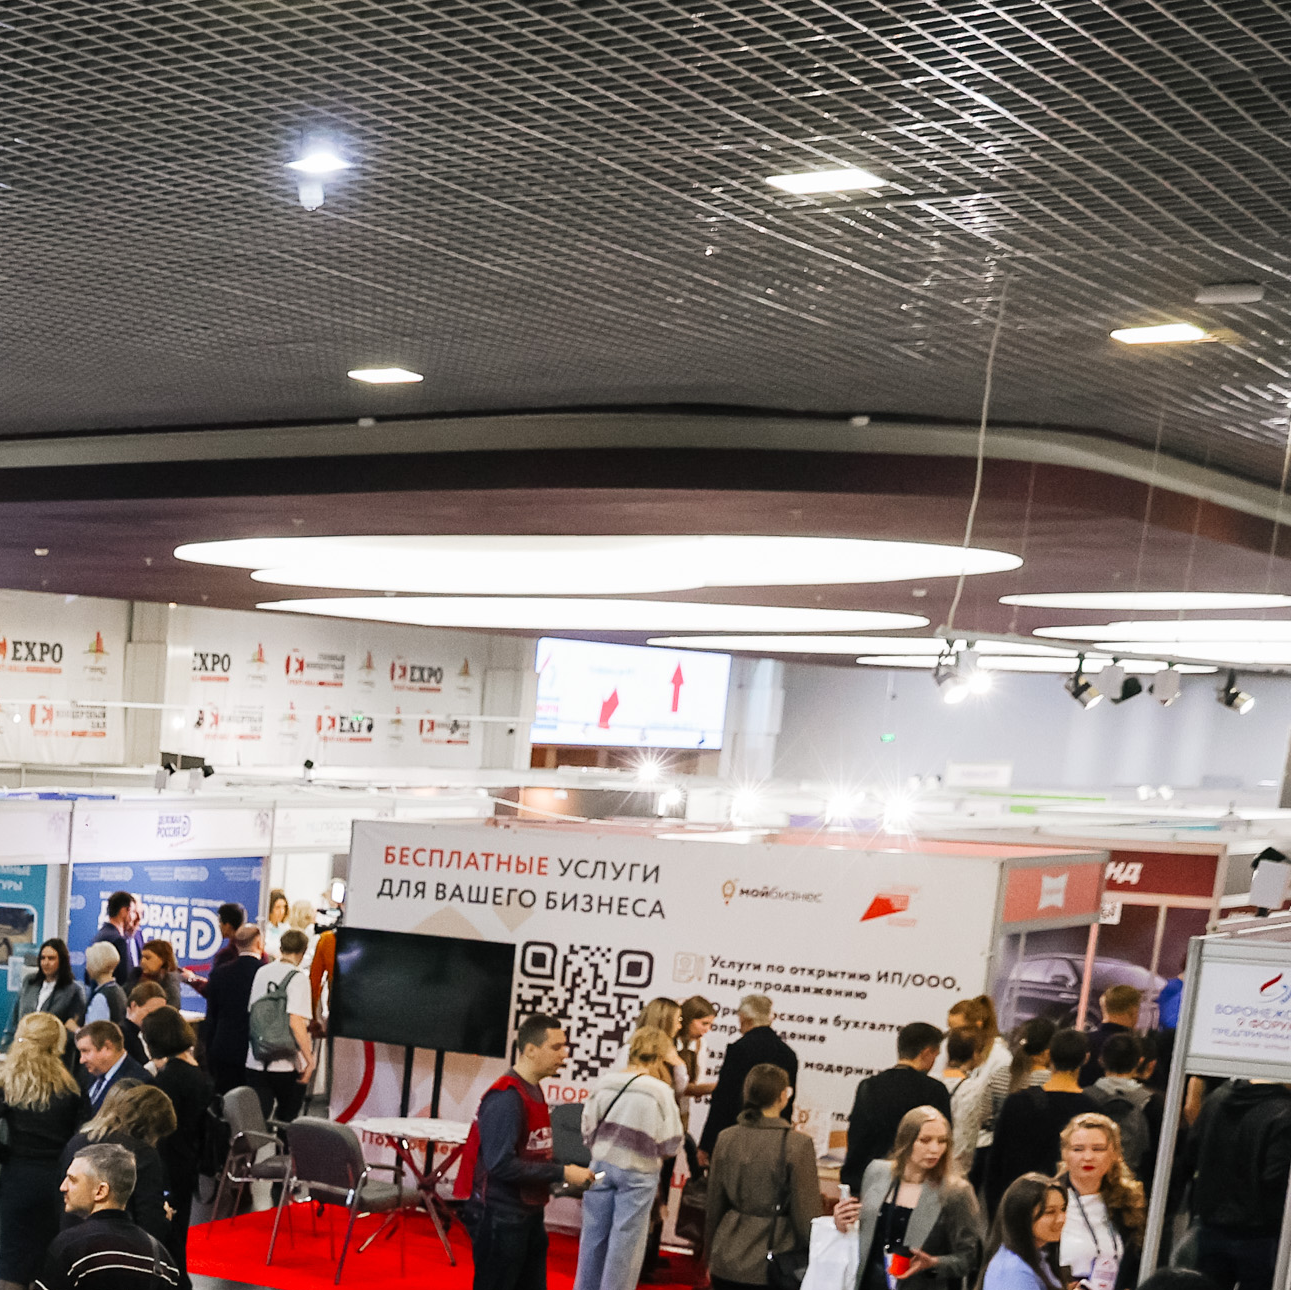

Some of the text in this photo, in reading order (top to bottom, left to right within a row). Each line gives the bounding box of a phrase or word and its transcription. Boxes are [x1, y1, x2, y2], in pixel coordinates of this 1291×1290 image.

[11, 640, 64, 664] EXPO
[409, 665, 444, 684] EXPO
[384, 845, 660, 884] БЕСПЛАТНЫЕ УСЛУГИ
[377, 879, 666, 919] ДЛЯ ВАШЕГО БИЗНЕСА
[709, 955, 761, 972] Услуги
[766, 963, 784, 974] по
[789, 965, 871, 982] открытию
[708, 973, 868, 1000] Пиар-продвижению
[833, 1015, 901, 1033] бухгалте
